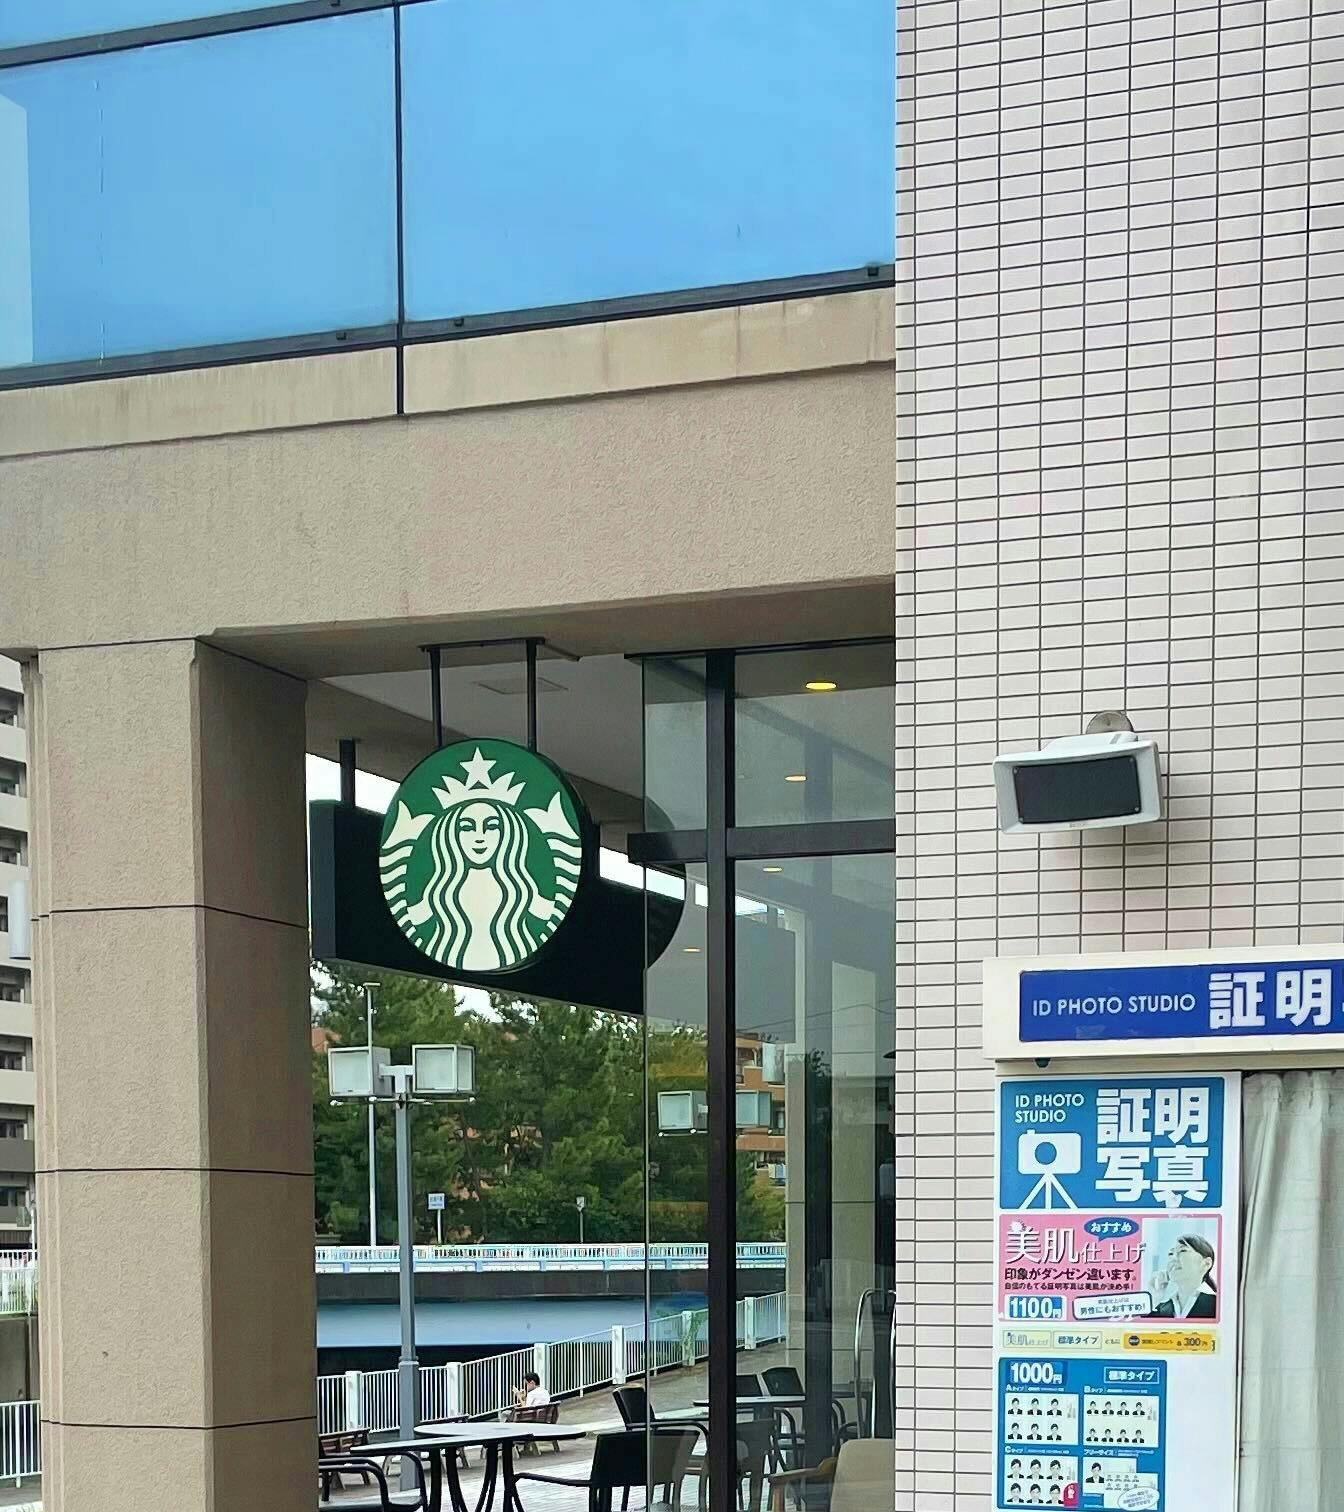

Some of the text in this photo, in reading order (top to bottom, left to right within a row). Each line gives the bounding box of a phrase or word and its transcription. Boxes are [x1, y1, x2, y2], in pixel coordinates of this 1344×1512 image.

[1033, 993, 1197, 1017] ID PHOTO STUDIO
[1015, 1093, 1085, 1107] ID PHOTO
[1015, 1109, 1067, 1124] STUDIO
[1096, 1087, 1209, 1144] 証明
[1095, 1145, 1209, 1205] 写真
[1090, 1221, 1132, 1233] おすすめ
[1006, 1227, 1147, 1264] 美肌仕上げ
[1010, 1297, 1062, 1318] 1100円
[1010, 1362, 1063, 1384] 1000円
